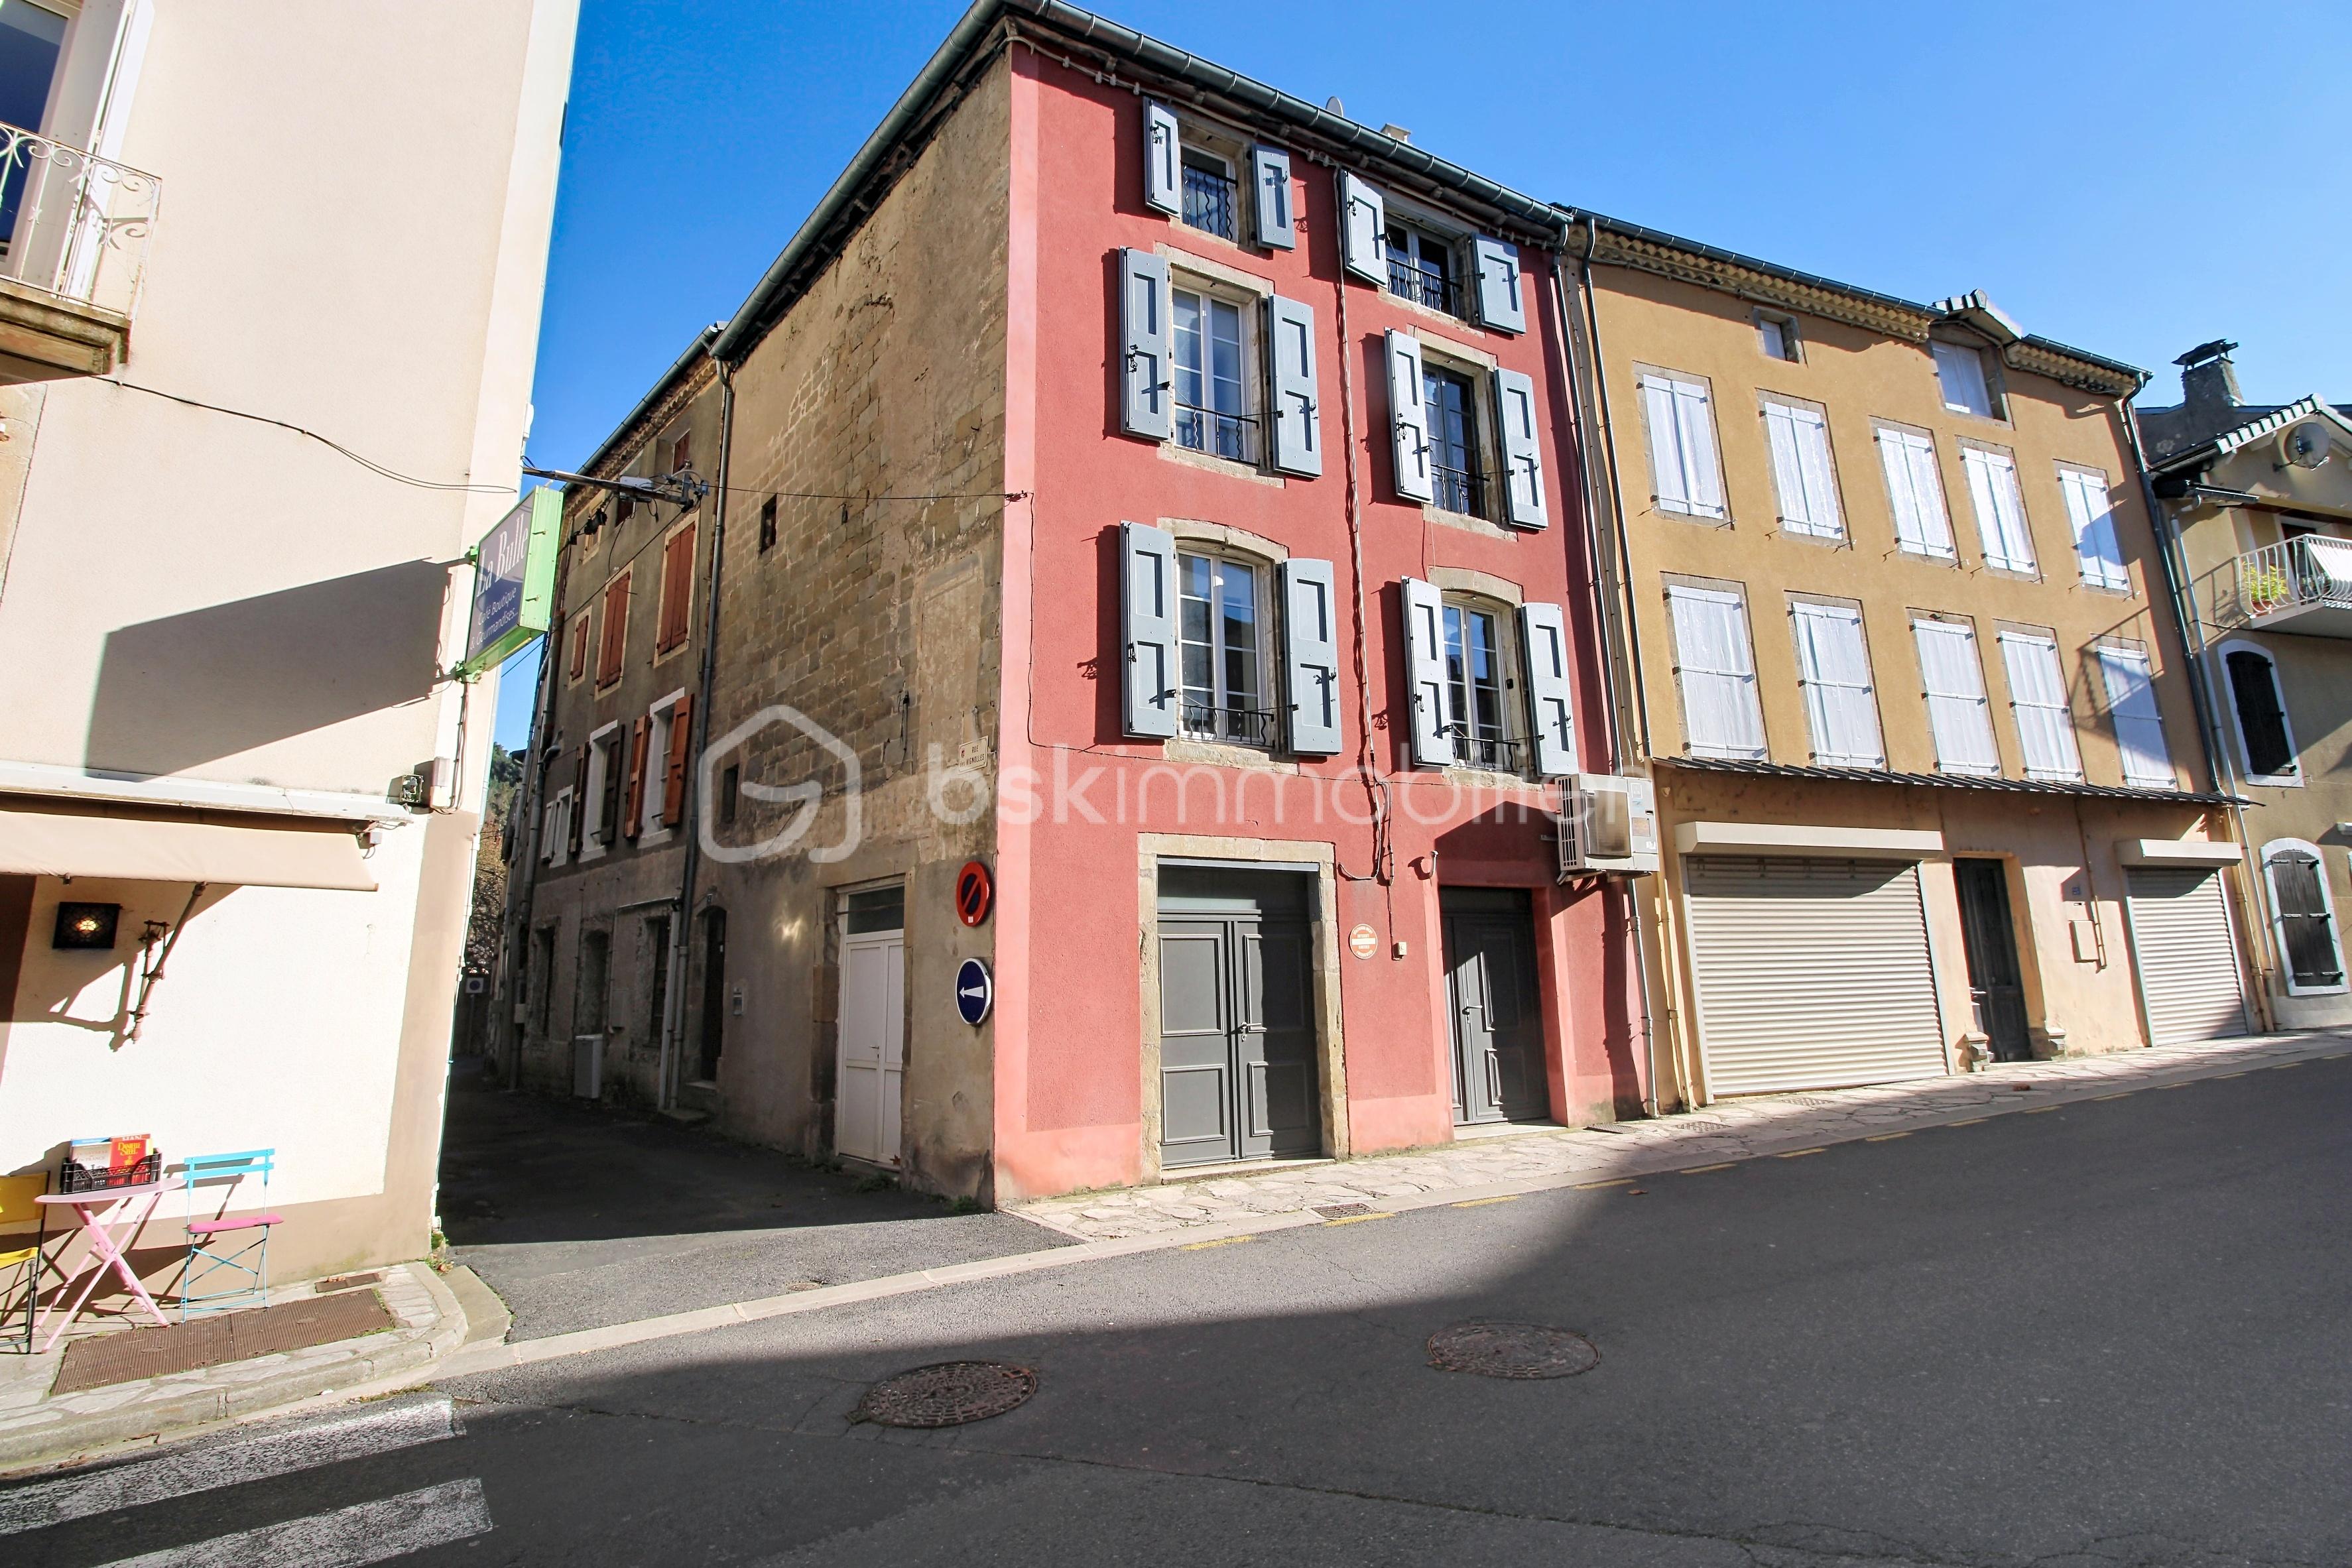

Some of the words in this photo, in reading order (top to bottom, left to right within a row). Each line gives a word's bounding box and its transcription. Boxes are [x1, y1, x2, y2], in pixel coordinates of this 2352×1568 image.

[476, 549, 493, 597] La
[495, 513, 528, 583] Bulle
[478, 604, 491, 626] Café
[492, 587, 517, 615] Boutique
[967, 754, 984, 765] VIGNOLLES
